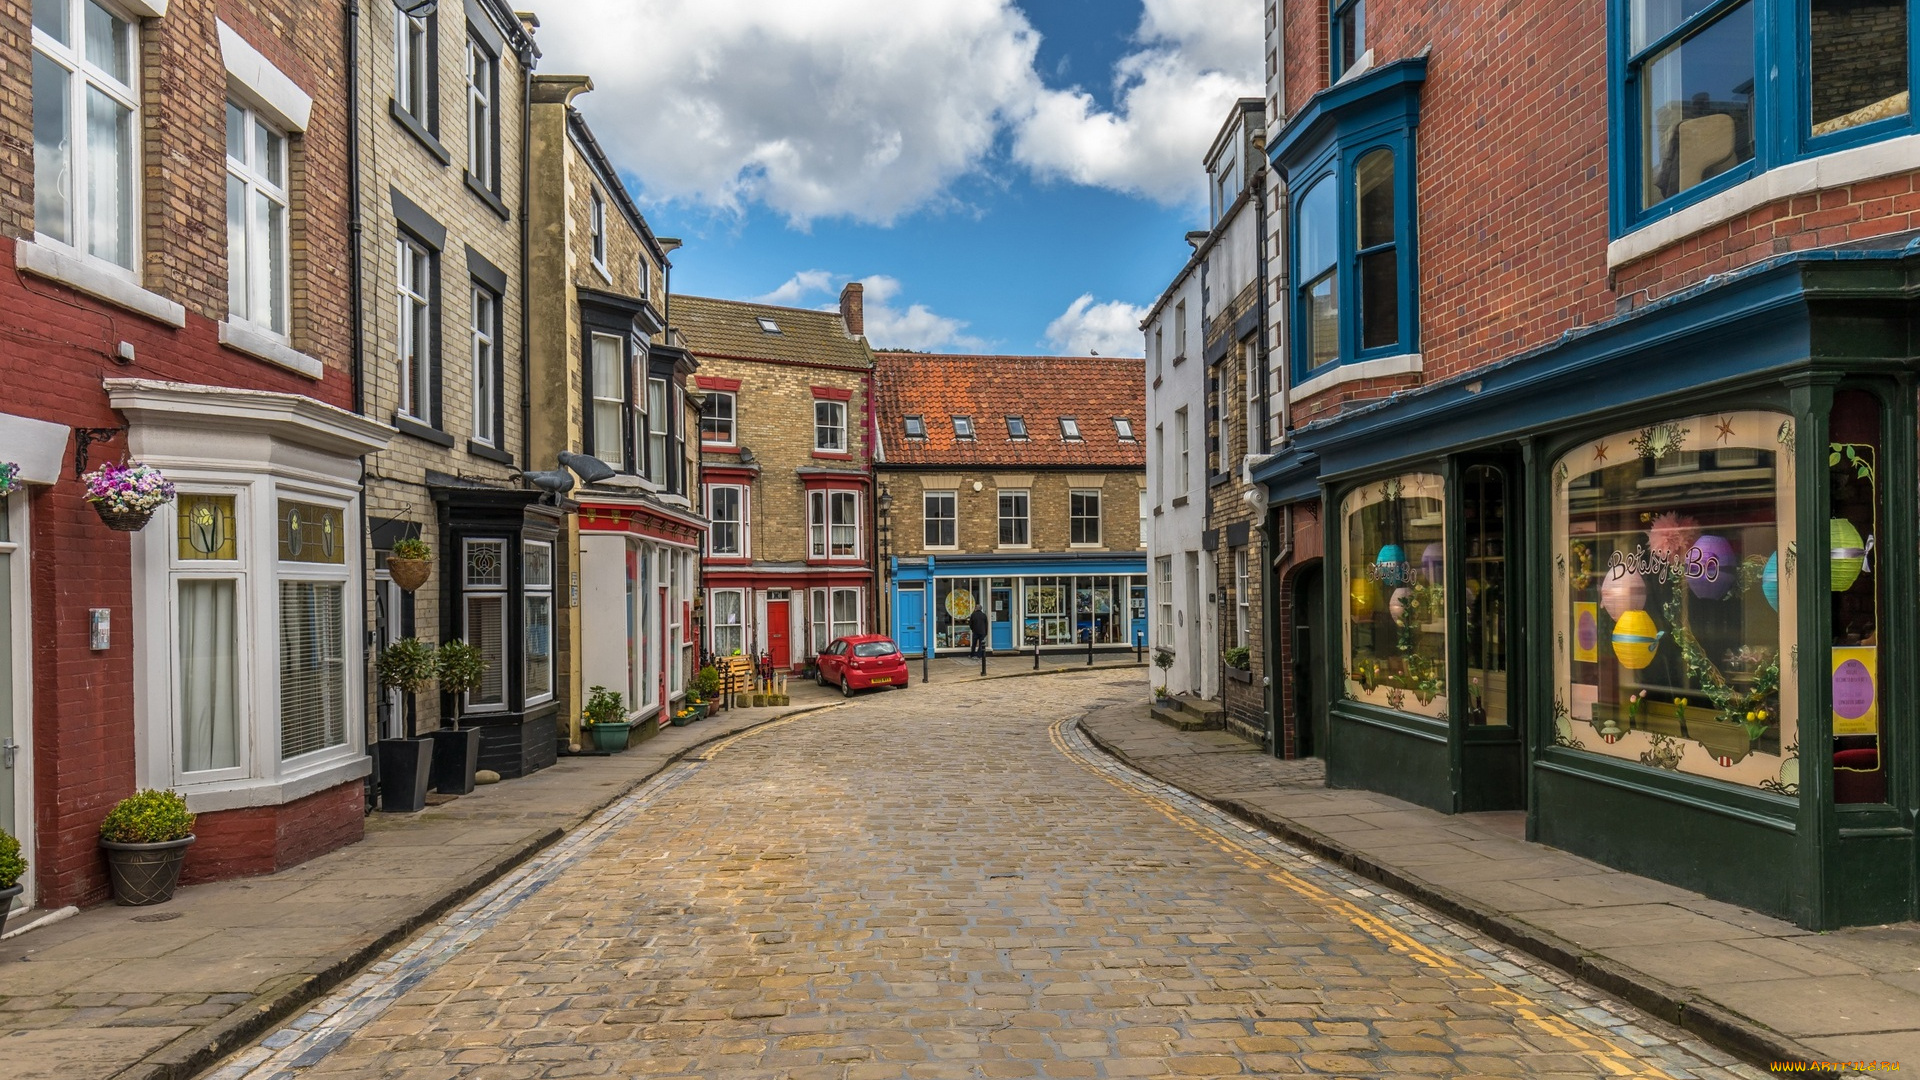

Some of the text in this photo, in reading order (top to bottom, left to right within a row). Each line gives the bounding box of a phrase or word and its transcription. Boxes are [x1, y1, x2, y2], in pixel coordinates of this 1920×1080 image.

[1400, 561, 1417, 586] Bo
[1607, 544, 1670, 585] Betsy
[1684, 546, 1720, 582] Bo
